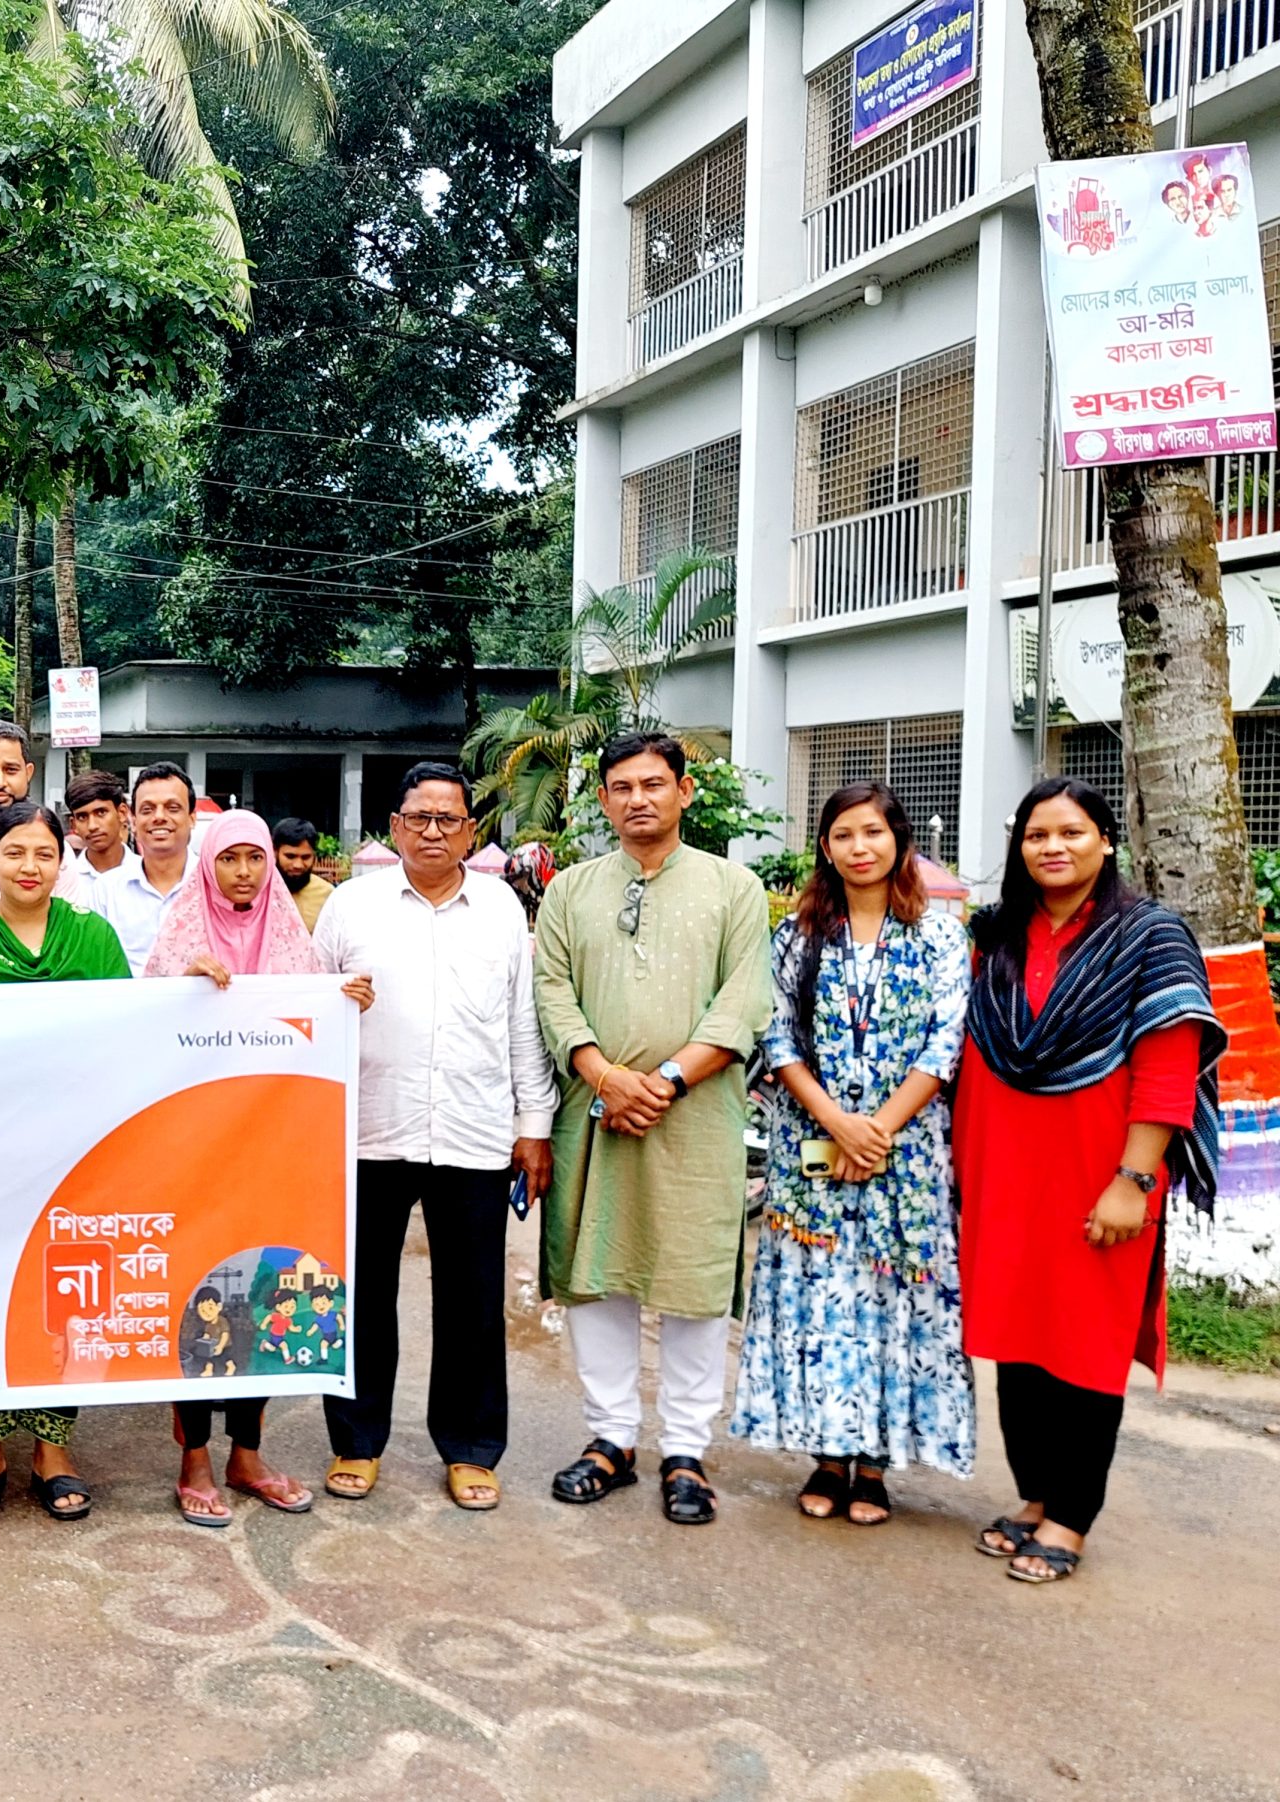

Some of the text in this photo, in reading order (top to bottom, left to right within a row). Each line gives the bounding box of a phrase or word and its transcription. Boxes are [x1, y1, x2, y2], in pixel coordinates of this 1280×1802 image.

[1061, 291, 1109, 314] মোদের
[1147, 281, 1197, 306] মোদের
[1105, 336, 1213, 363] বাংলা ভাষা
[1080, 638, 1125, 663] উপজেল
[177, 1030, 293, 1047] World Vision
[47, 1206, 176, 1240] শিশুশ্রমকে
[52, 1243, 169, 1309] না বলি
[115, 1292, 169, 1311] শোভন
[70, 1312, 169, 1335] কর্মপরিবেশ
[73, 1335, 169, 1361] নিশ্চিত করি
